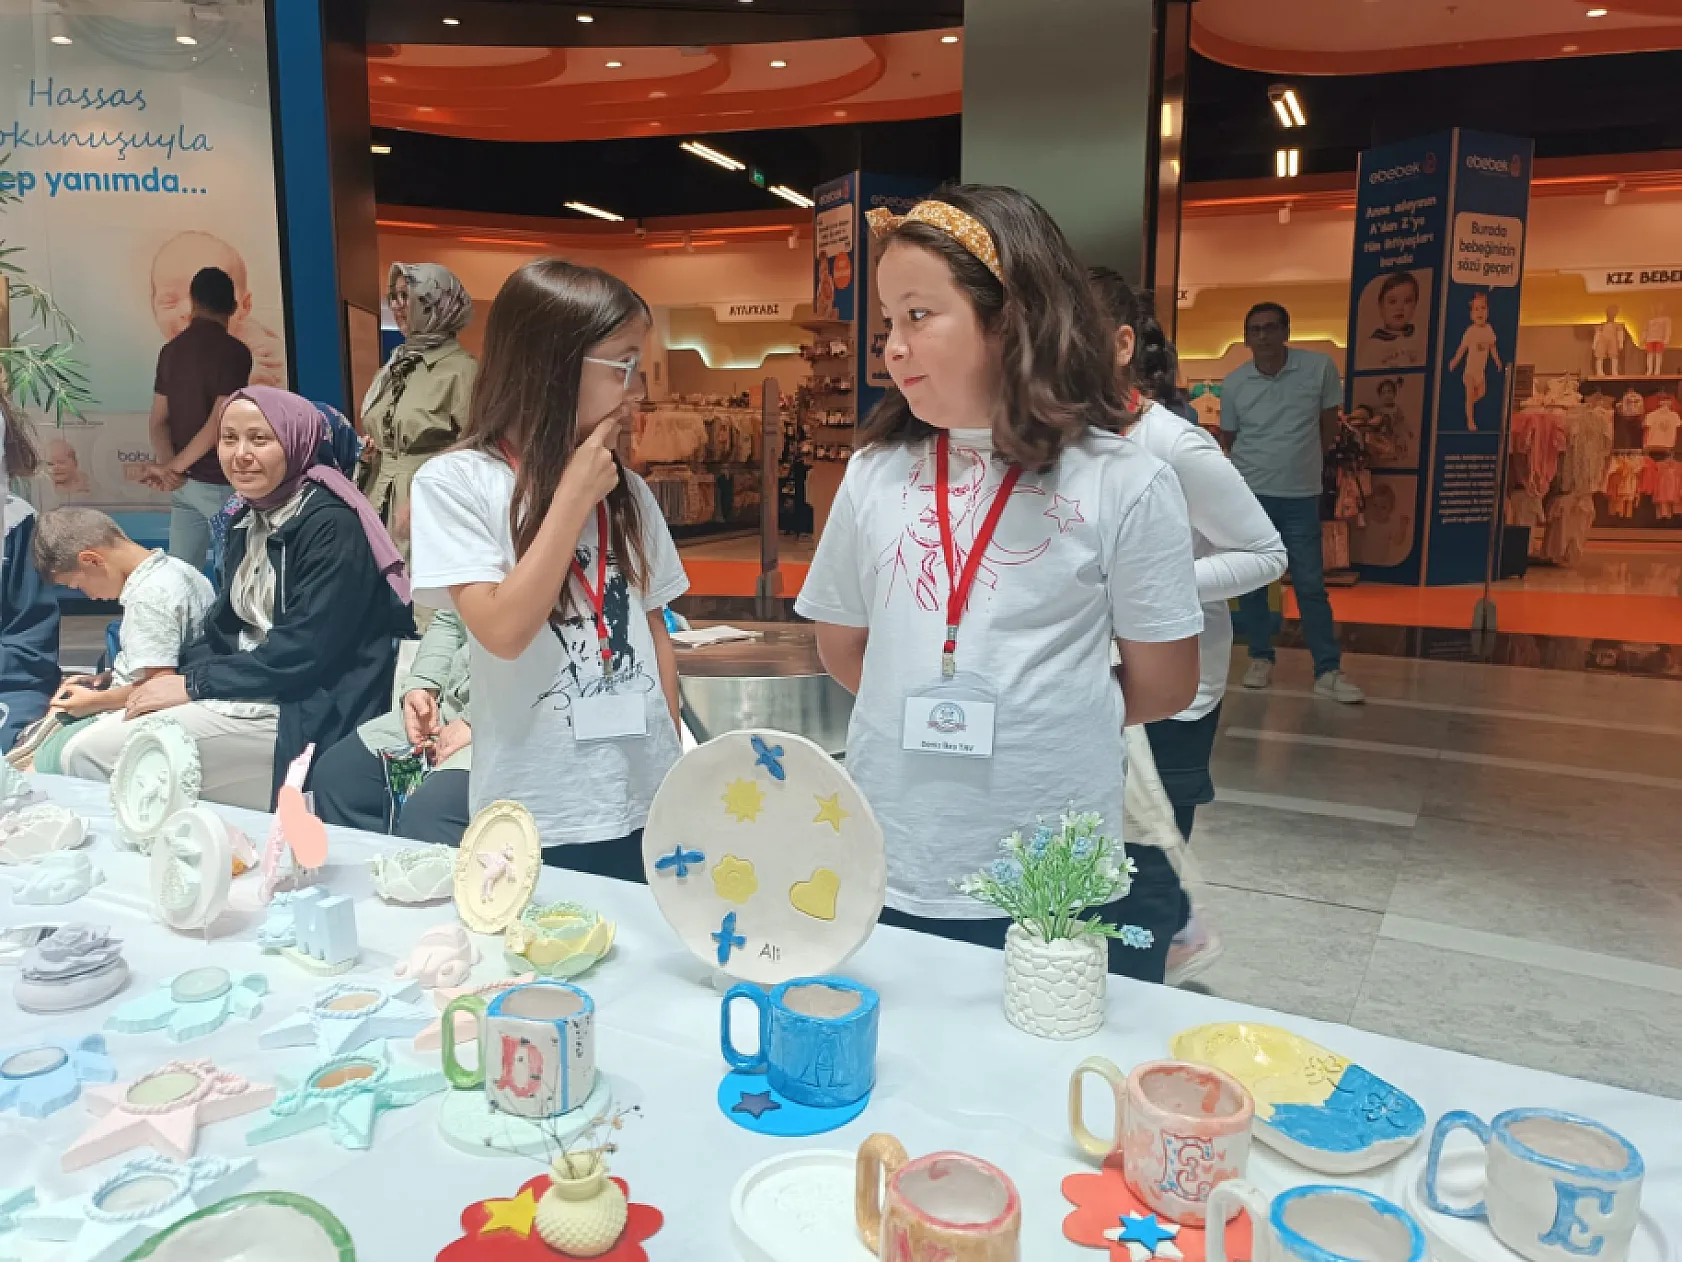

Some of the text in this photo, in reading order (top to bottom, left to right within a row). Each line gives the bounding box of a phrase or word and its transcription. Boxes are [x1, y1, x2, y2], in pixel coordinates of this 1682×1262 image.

[29, 77, 148, 111] Hassas
[45, 166, 208, 198] yanımda...
[1471, 221, 1508, 238] Burada
[1606, 269, 1682, 285] KIZ BEBE
[759, 942, 781, 961] Ali
[1538, 1181, 1618, 1256] E
